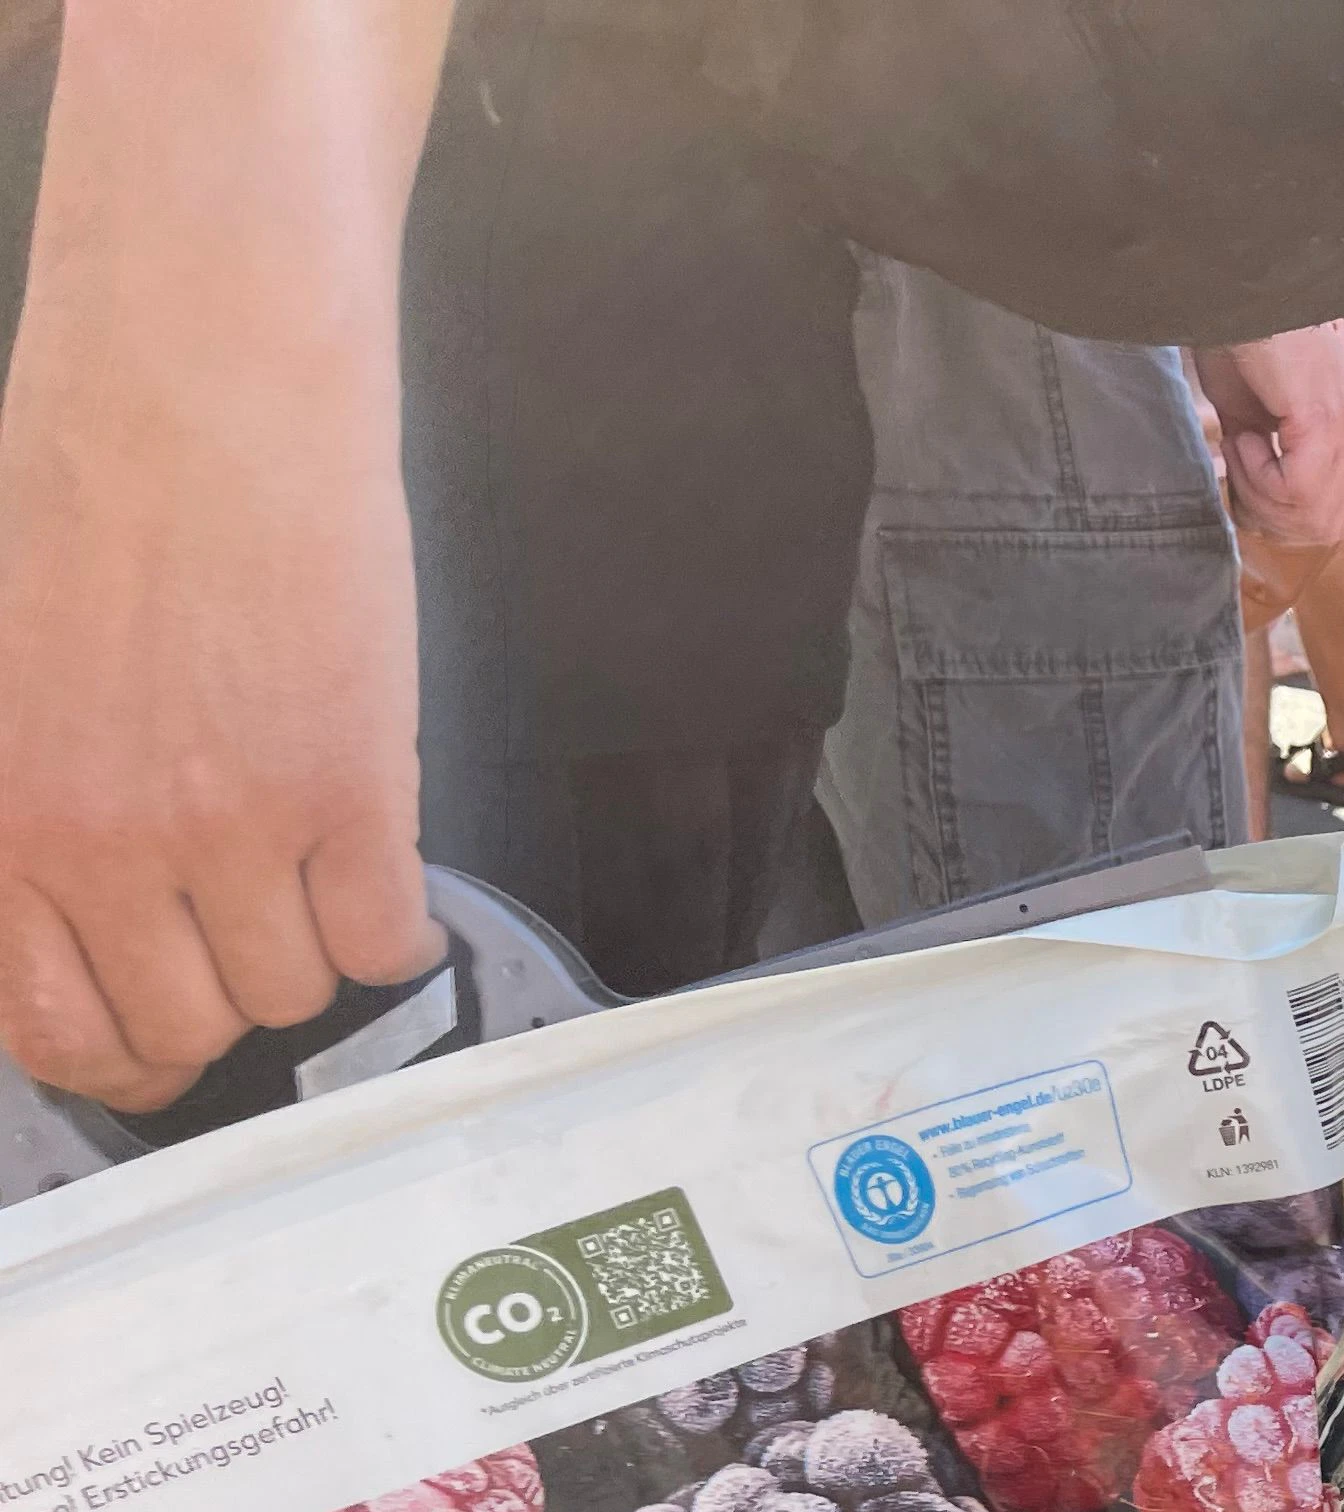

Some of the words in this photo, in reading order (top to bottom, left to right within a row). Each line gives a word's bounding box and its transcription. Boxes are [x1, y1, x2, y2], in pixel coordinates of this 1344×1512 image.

[1206, 1044, 1229, 1061] 04
[1202, 1073, 1246, 1093] LDPE
[1206, 1166, 1233, 1179] KLN:
[0, 1455, 77, 1503] tung!
[77, 1435, 143, 1473] Kein
[143, 1376, 290, 1446] Spielzeug!
[80, 1397, 340, 1511] Erstickungsgefahr!
